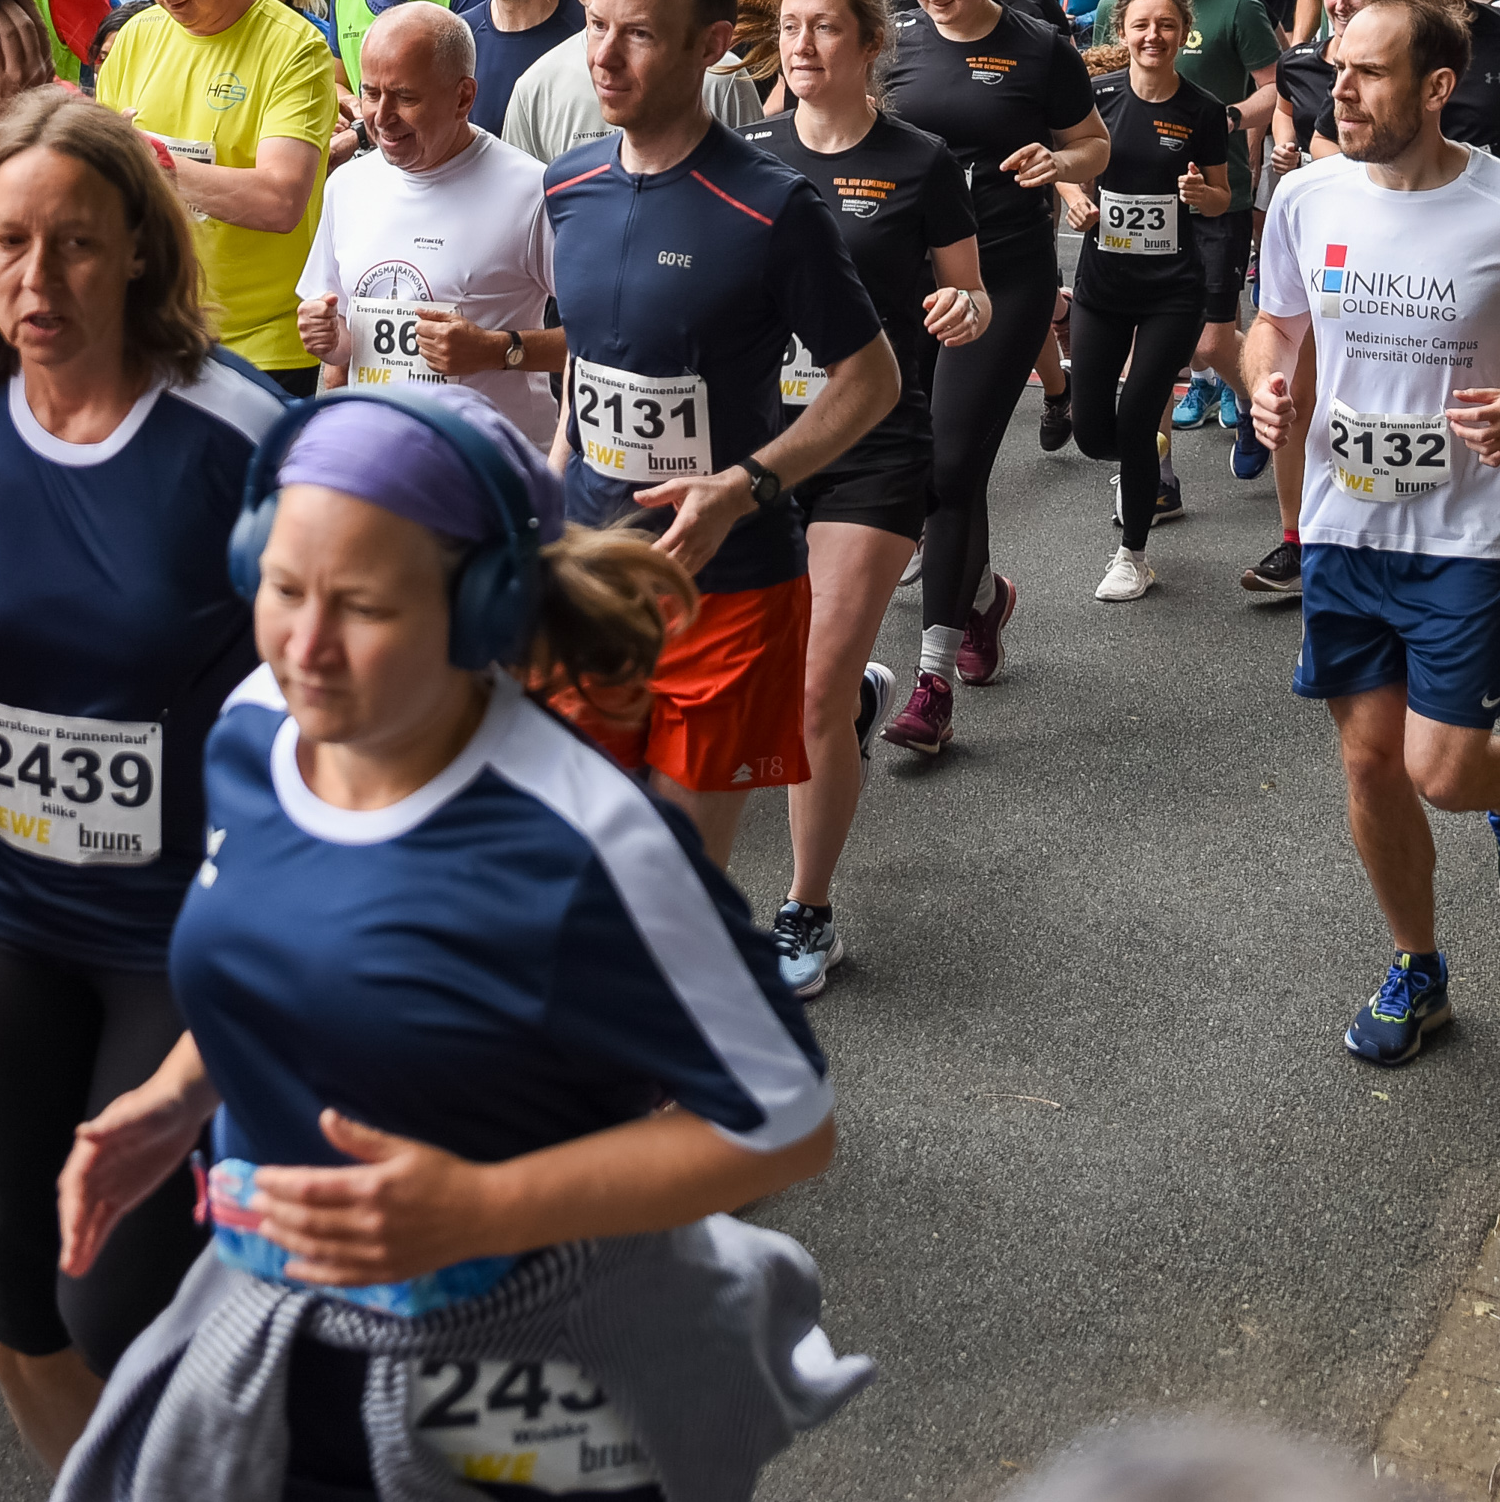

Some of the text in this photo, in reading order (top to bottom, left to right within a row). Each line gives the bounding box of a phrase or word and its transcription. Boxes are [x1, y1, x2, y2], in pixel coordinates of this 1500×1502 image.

[206, 82, 247, 101] HFS
[572, 129, 612, 141] Everstener
[1108, 205, 1166, 231] 923
[1104, 234, 1171, 249] EWE bruns
[657, 250, 693, 268] GORE
[1310, 268, 1457, 303] KLINIKUM
[356, 304, 394, 316] Everstener
[1342, 298, 1457, 322] OLDENBURG
[1345, 330, 1479, 353] Medizinischer Campus
[381, 357, 414, 367] Thomas
[1346, 346, 1474, 369] Universität Oldenburg
[358, 366, 391, 384] EWE
[580, 369, 697, 395] Everstener Brunnenlauf
[794, 369, 827, 378] Mariek
[779, 380, 808, 397] WE
[578, 382, 697, 439] 2131
[1333, 408, 1442, 430] Everstener Brunnenlauf
[612, 435, 654, 450] Thomas
[1331, 419, 1446, 467] 2132
[587, 439, 697, 470] EWE bruns
[1338, 466, 1438, 494] EWE bruns
[1372, 467, 1390, 476] Ole
[56, 727, 149, 746] Brunnenlauf
[756, 755, 783, 778] T8
[41, 801, 78, 819] Hilke
[78, 823, 143, 852] bruns
